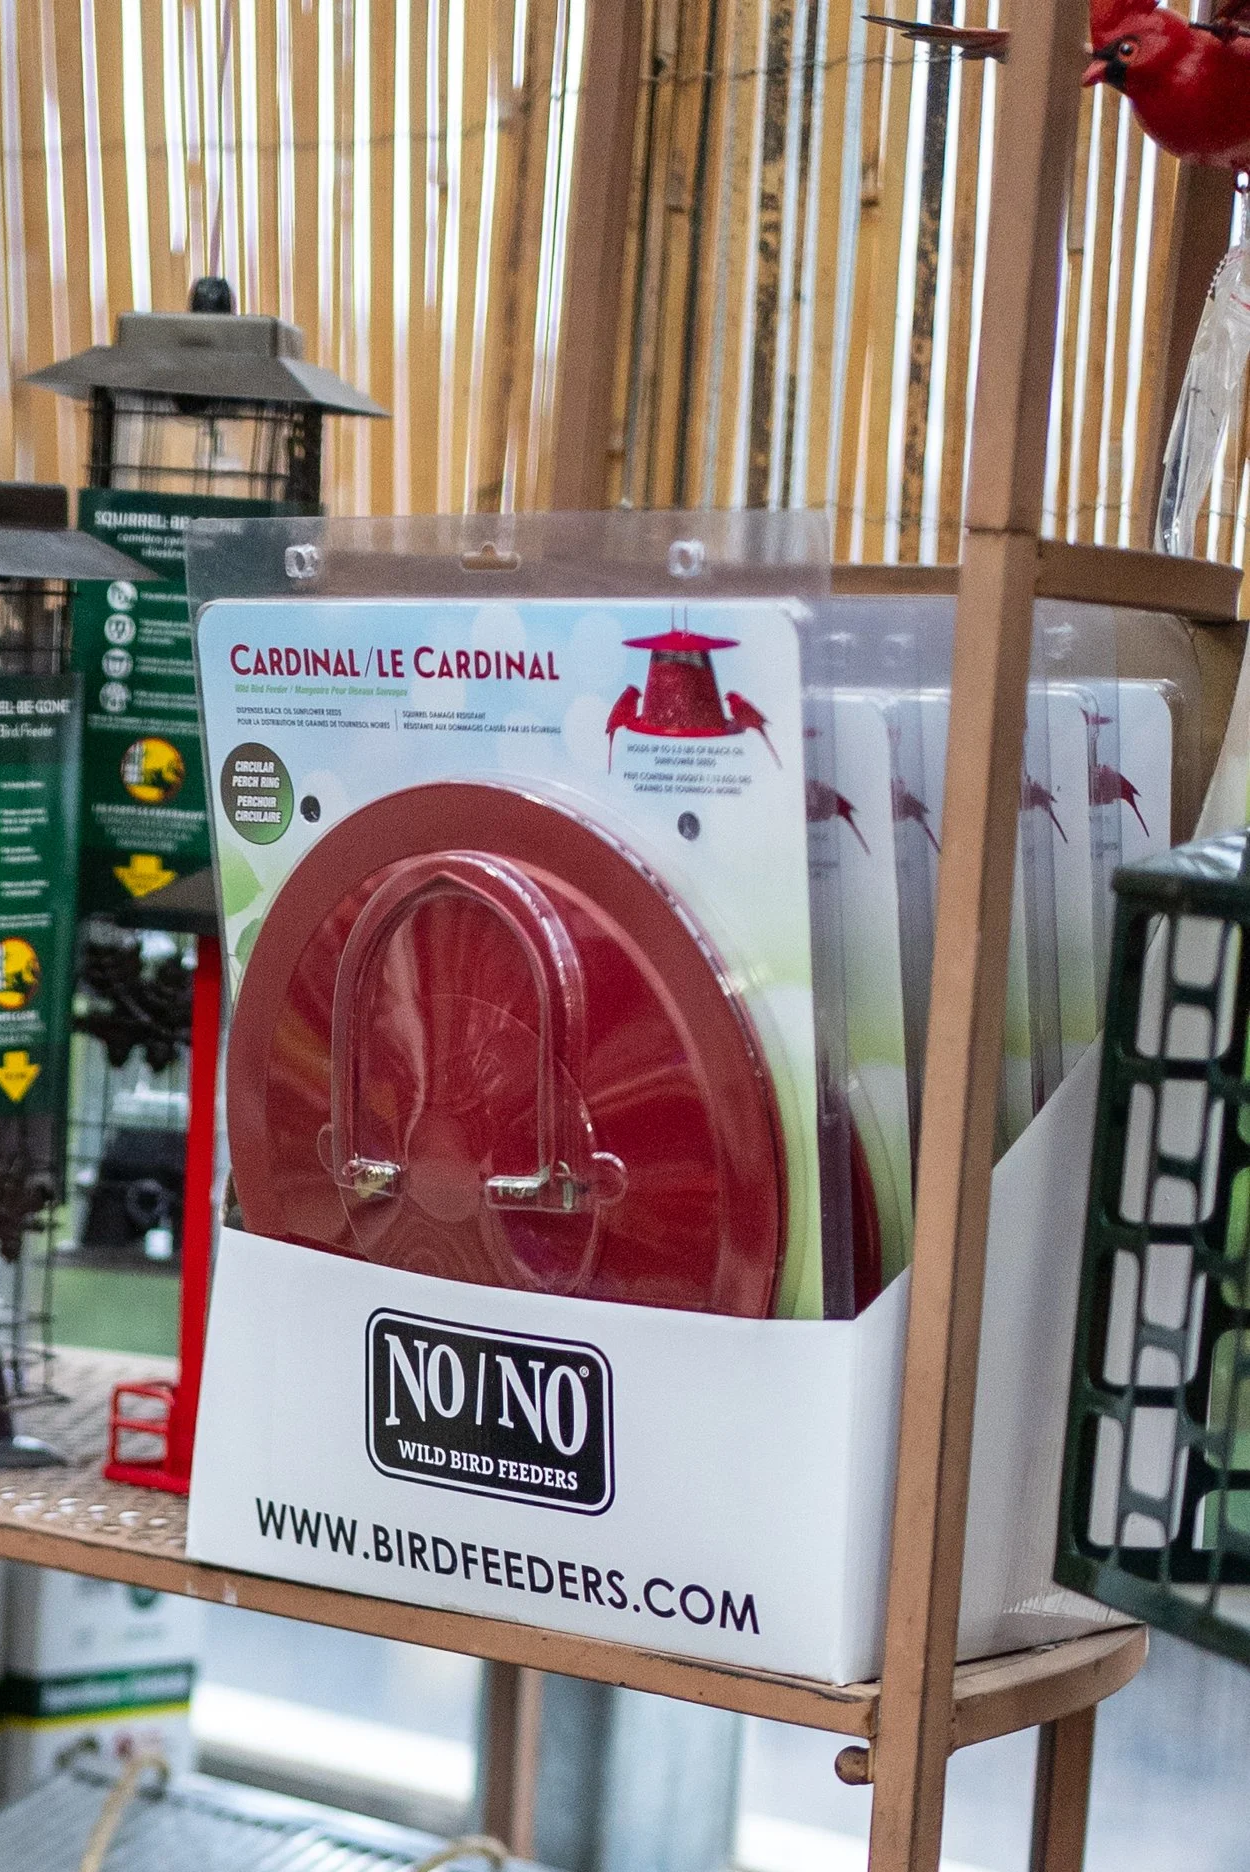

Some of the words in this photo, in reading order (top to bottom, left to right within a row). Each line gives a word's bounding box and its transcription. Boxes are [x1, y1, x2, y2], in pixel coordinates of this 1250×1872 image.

[413, 646, 560, 681] CARDINAL
[264, 707, 282, 715] BLACK
[283, 707, 292, 715] OIL
[293, 707, 325, 716] SUNFLOWER
[326, 708, 342, 717] SEEDS
[237, 718, 252, 726] POUR
[297, 719, 304, 727] DE
[305, 720, 329, 728] GRAINES
[330, 720, 337, 728] DE
[338, 720, 369, 729] TOURNESOL
[370, 721, 390, 730] NOIRES
[235, 760, 275, 773] CIRCULAR
[232, 775, 259, 788] PERCH
[260, 776, 280, 788] RING
[236, 795, 277, 807] PERCHOIR
[235, 810, 282, 823] CIRCULAIRE
[398, 1439, 447, 1467] WILD
[449, 1450, 495, 1475] BIRD
[498, 1458, 579, 1491] FEEDERS
[256, 1497, 760, 1635] WWW.BIRDFEEDERS.COM
